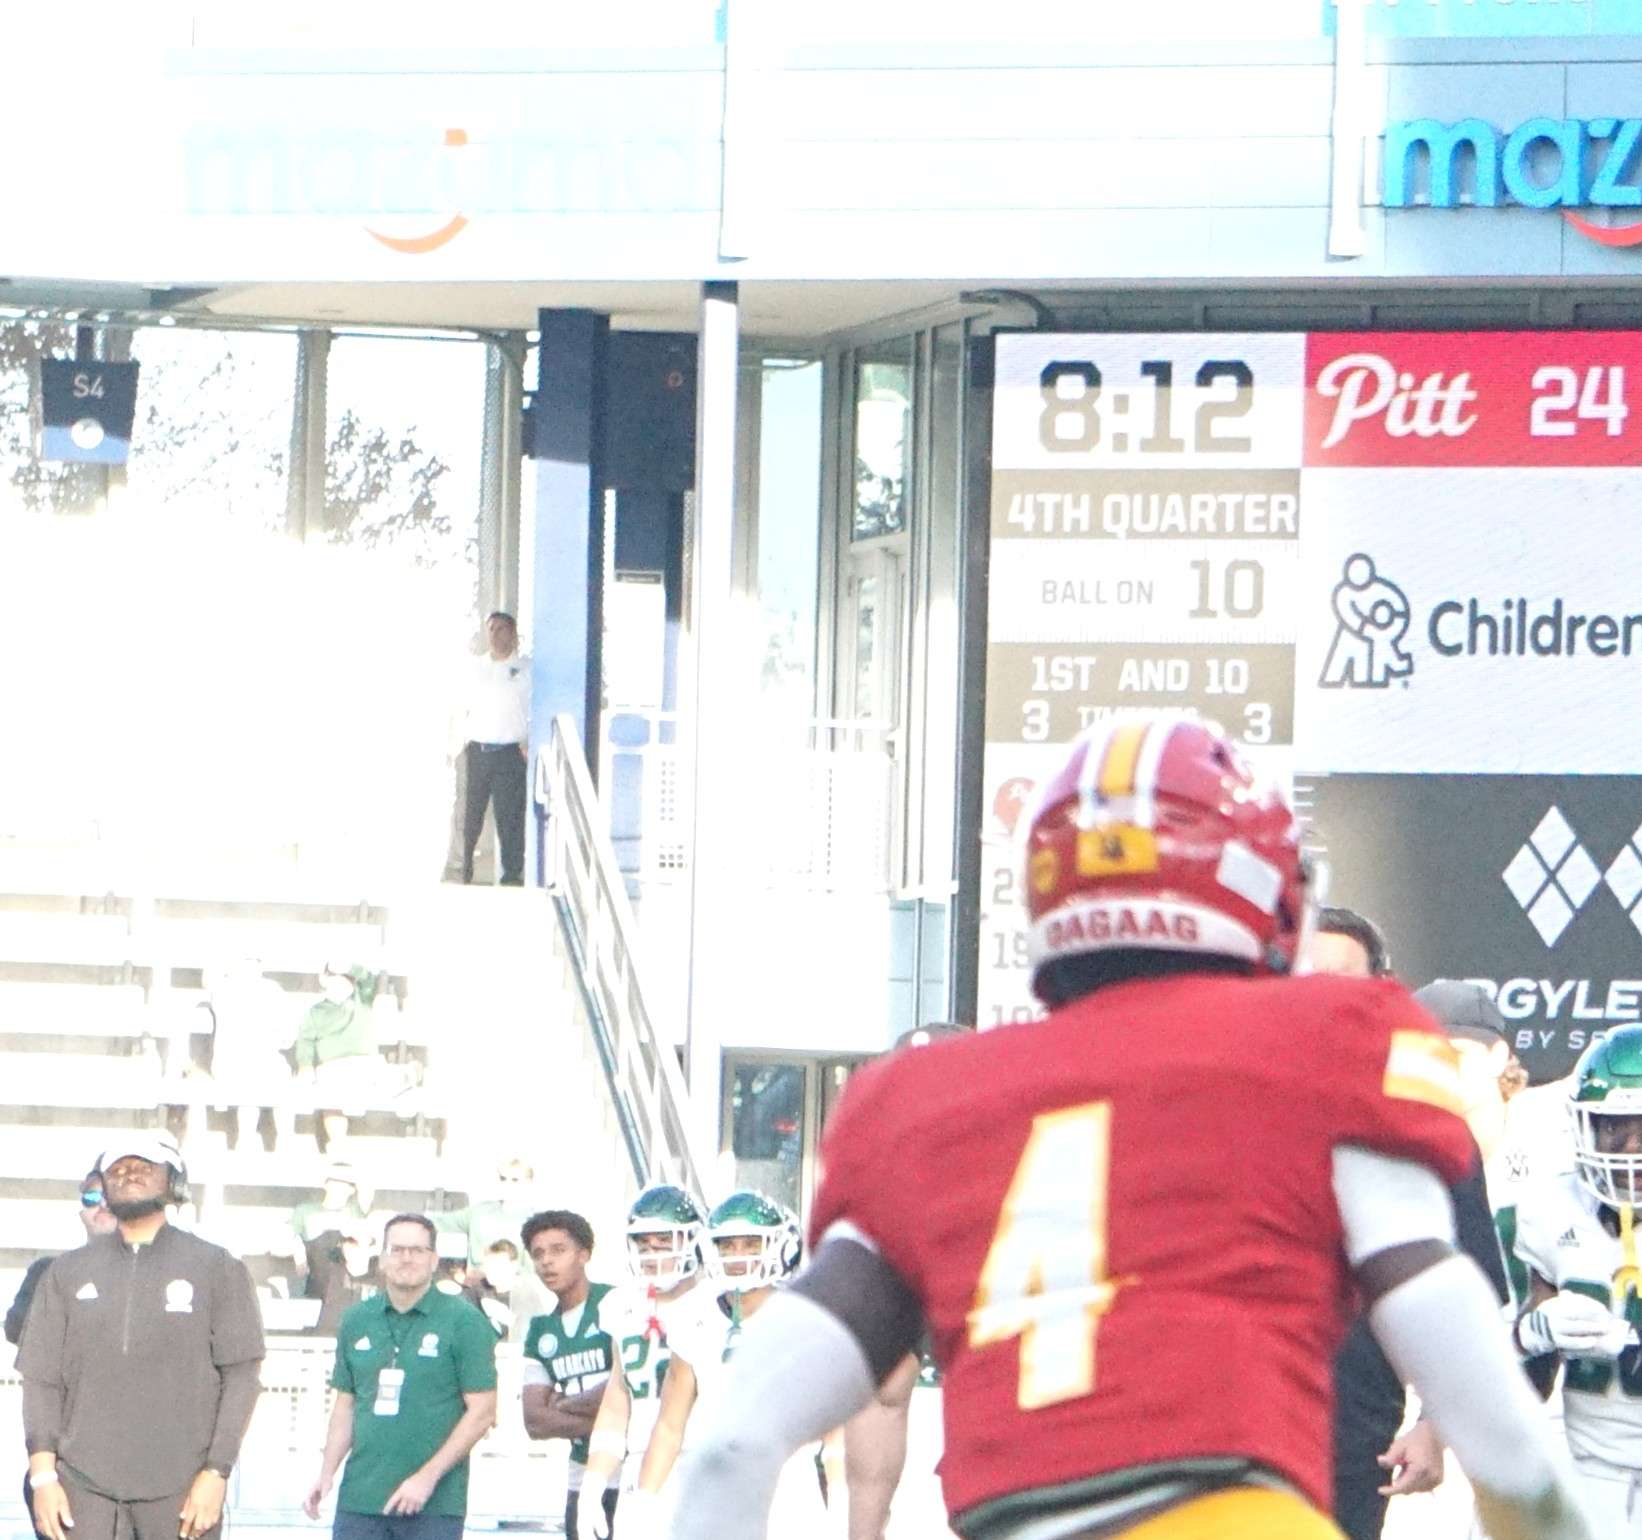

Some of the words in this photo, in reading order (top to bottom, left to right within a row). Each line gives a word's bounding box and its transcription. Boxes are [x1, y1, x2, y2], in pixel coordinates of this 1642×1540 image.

[73, 374, 105, 400] S4
[1038, 360, 1255, 454] 8:12
[1316, 352, 1478, 449] Pitt
[1530, 366, 1629, 436] 24
[1007, 493, 1091, 532] 4TH
[1101, 493, 1298, 540] QUARTER
[1041, 578, 1107, 605] BALL
[1116, 579, 1155, 605] ON
[1187, 558, 1266, 620] 10
[1031, 656, 1096, 692] 1ST
[1117, 658, 1190, 693] AND
[1204, 658, 1250, 695] 10
[1021, 699, 1050, 742] 3
[1242, 702, 1272, 745] 3
[1515, 1029, 1556, 1049] BY
[966, 1100, 1118, 1411] 4
